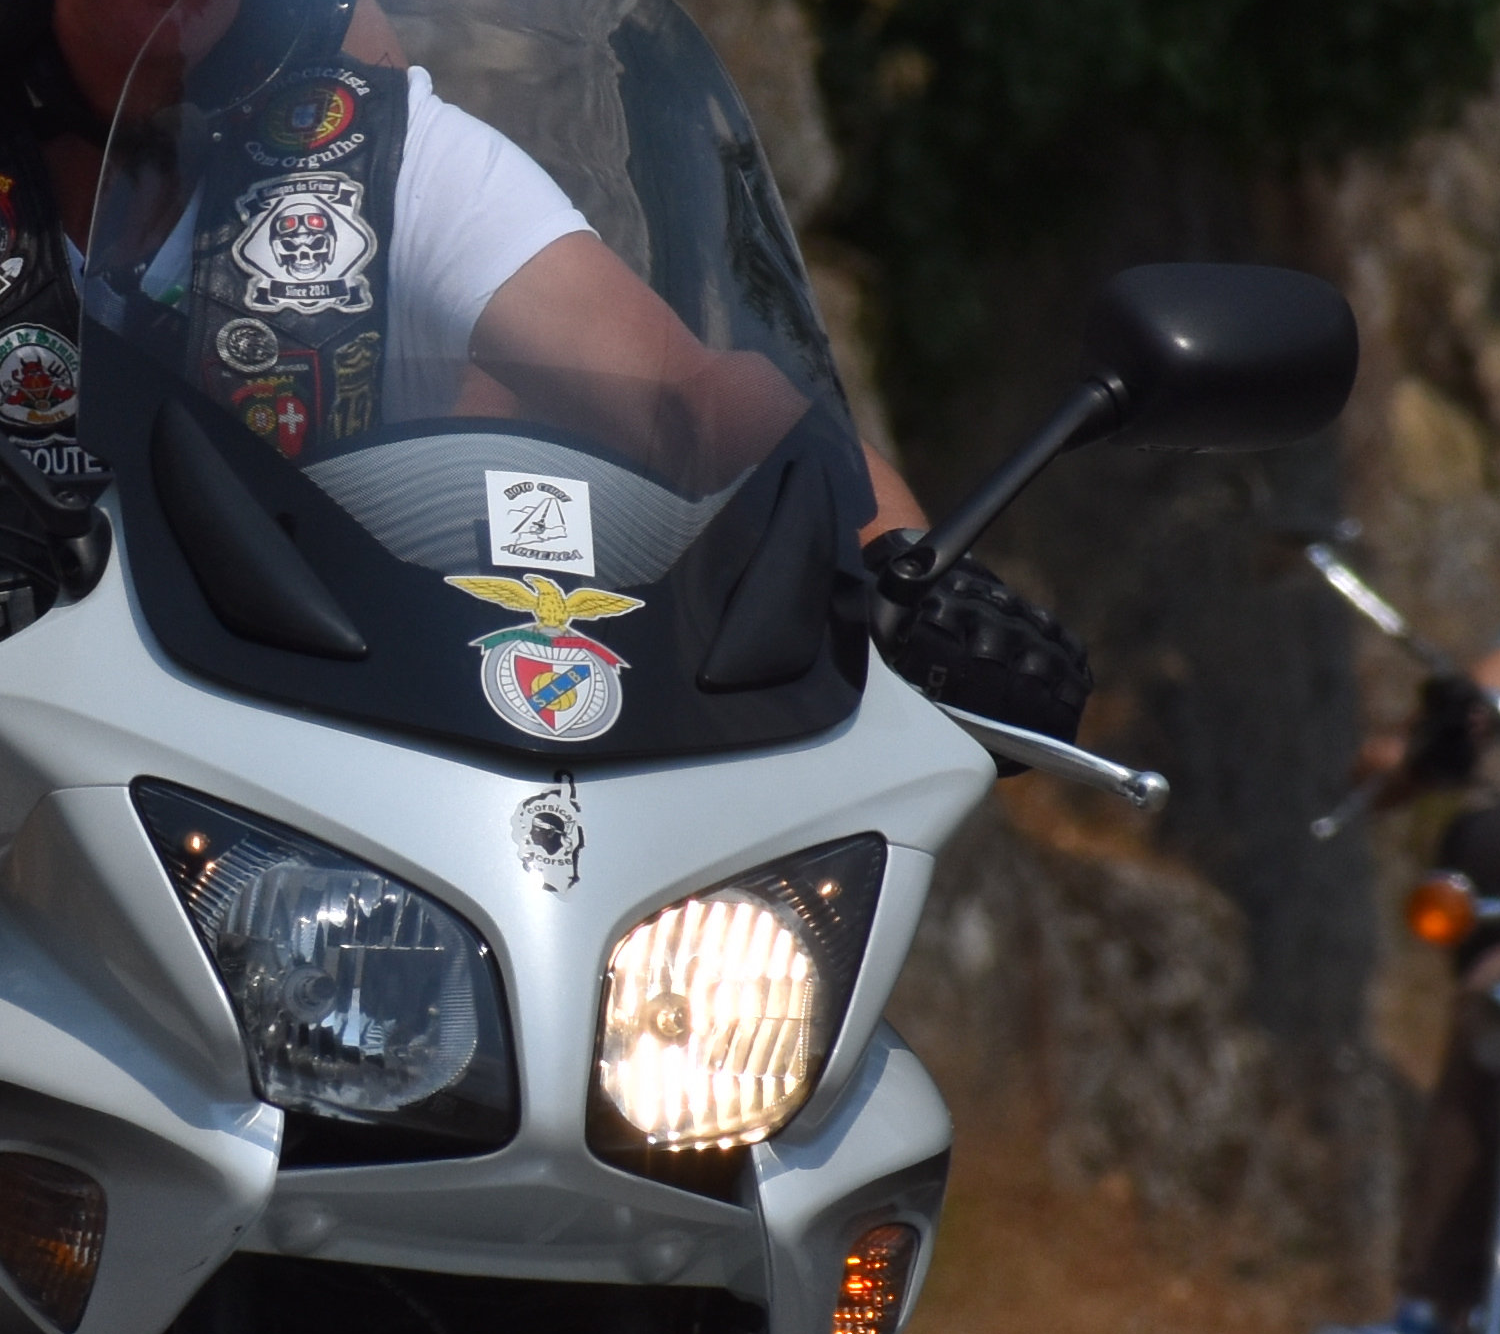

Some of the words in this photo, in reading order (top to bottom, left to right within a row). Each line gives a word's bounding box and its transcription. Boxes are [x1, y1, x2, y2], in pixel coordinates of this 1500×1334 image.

[281, 132, 365, 169] Orgulho
[285, 284, 307, 297] Since
[309, 284, 331, 297] 2021
[503, 481, 535, 501] MOTO
[526, 803, 574, 823] corsica
[535, 853, 574, 867] corse
